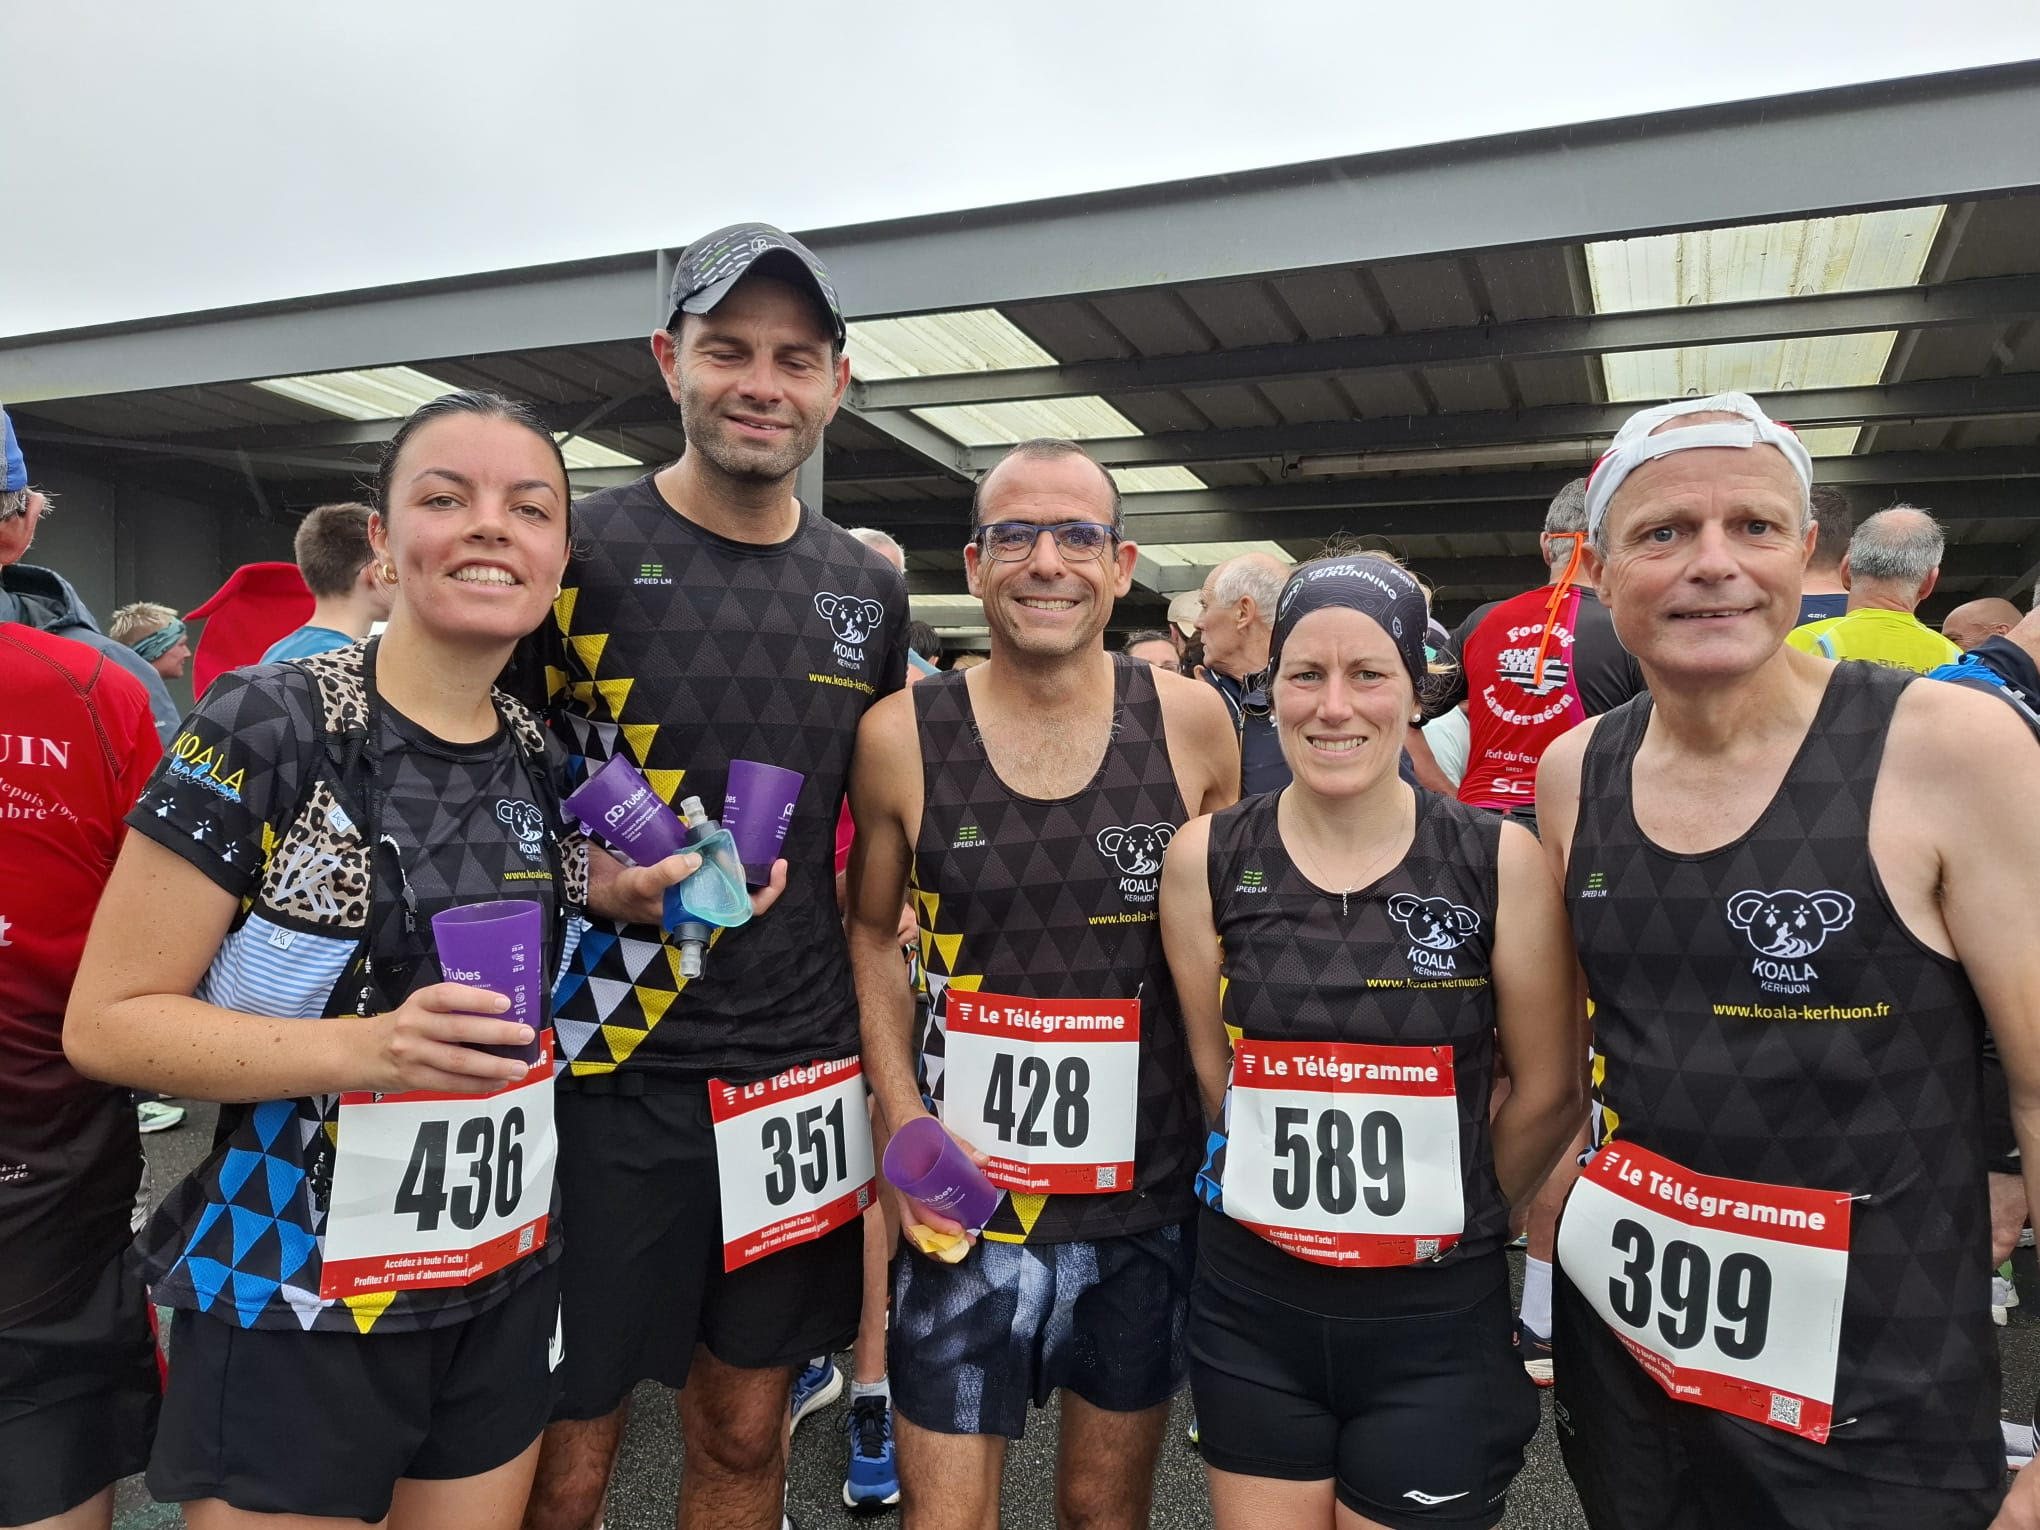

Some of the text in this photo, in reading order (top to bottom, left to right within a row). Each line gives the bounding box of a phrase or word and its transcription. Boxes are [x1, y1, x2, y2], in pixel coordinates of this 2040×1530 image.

[634, 577, 658, 585] SPEED
[1506, 622, 1576, 647] Fooing
[833, 641, 865, 661] KOALA
[1482, 684, 1574, 725] Landernéen
[171, 731, 245, 793] KOALA
[1503, 751, 1517, 761] du
[1518, 752, 1538, 763] feu
[622, 786, 646, 808] Tubes
[953, 840, 974, 849] SPEED
[1119, 877, 1158, 893] KOALA
[1235, 885, 1257, 893] SPEED
[1125, 893, 1154, 902] KERHUON
[1407, 946, 1456, 969] KOALA
[446, 967, 481, 980] Tubes
[1752, 958, 1818, 982] KOALA
[1760, 980, 1810, 994] KERHUON
[979, 1005, 1125, 1033] Le Télégramme
[1713, 1002, 1890, 1020] www.koala-kerhuon.fr
[1263, 1055, 1439, 1083] Le Télégramme
[744, 1083, 765, 1099] Le
[983, 1053, 1090, 1148] 428
[761, 1096, 847, 1206] 351
[394, 1106, 525, 1231] 436
[1002, 1162, 1014, 1171] toute
[1272, 1107, 1406, 1217] 589
[1618, 1159, 1825, 1230] Le Télégramme
[1294, 1231, 1298, 1241] à
[1299, 1233, 1314, 1243] toute
[1315, 1234, 1332, 1245] l'actu
[1296, 1245, 1337, 1258] d'abonnement
[384, 1257, 416, 1269] Accédez
[417, 1257, 422, 1266] à
[423, 1256, 441, 1265] toute
[443, 1254, 463, 1264] l'actu
[354, 1276, 382, 1287] Profitez
[384, 1273, 395, 1283] d'1
[397, 1271, 415, 1281] mois
[416, 1268, 468, 1281] d'abonnement
[1609, 1218, 1772, 1360] 399
